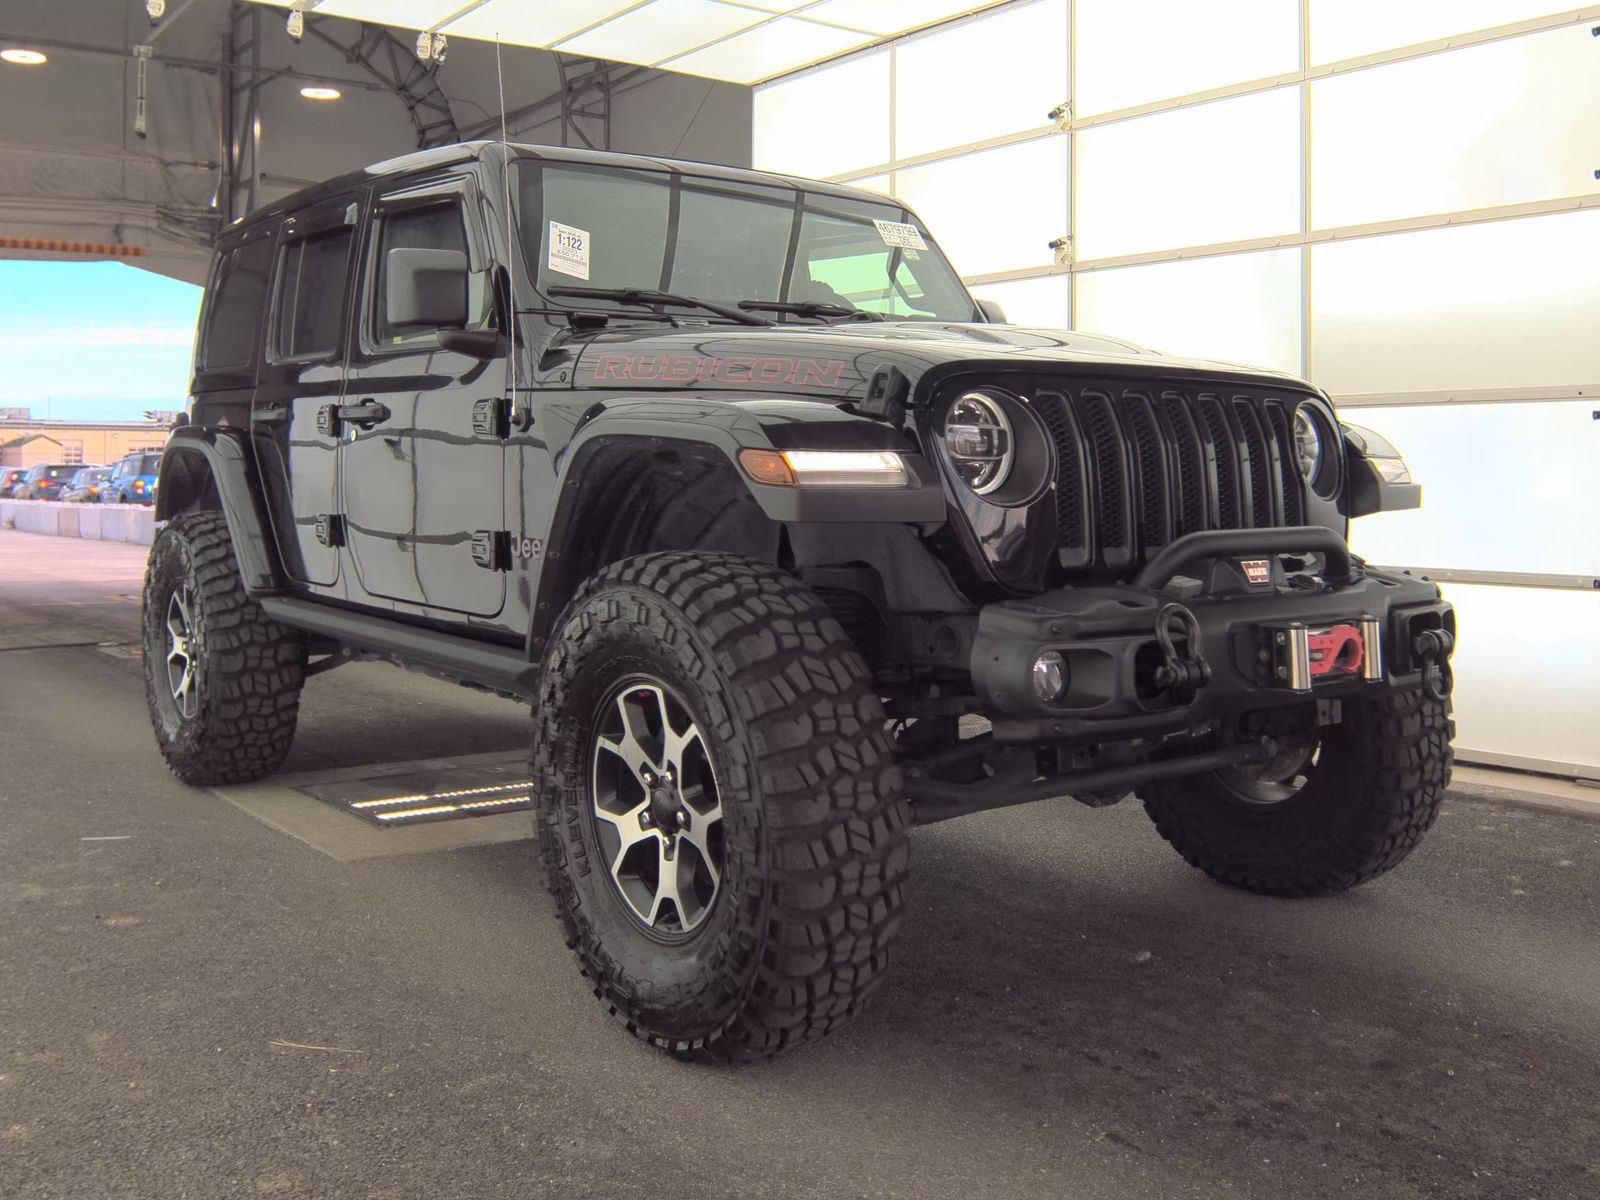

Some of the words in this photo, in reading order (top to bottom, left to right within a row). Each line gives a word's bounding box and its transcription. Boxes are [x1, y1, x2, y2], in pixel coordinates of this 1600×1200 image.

[557, 233, 582, 250] 1:122
[594, 355, 845, 387] RUBICON
[511, 533, 544, 559] Jee
